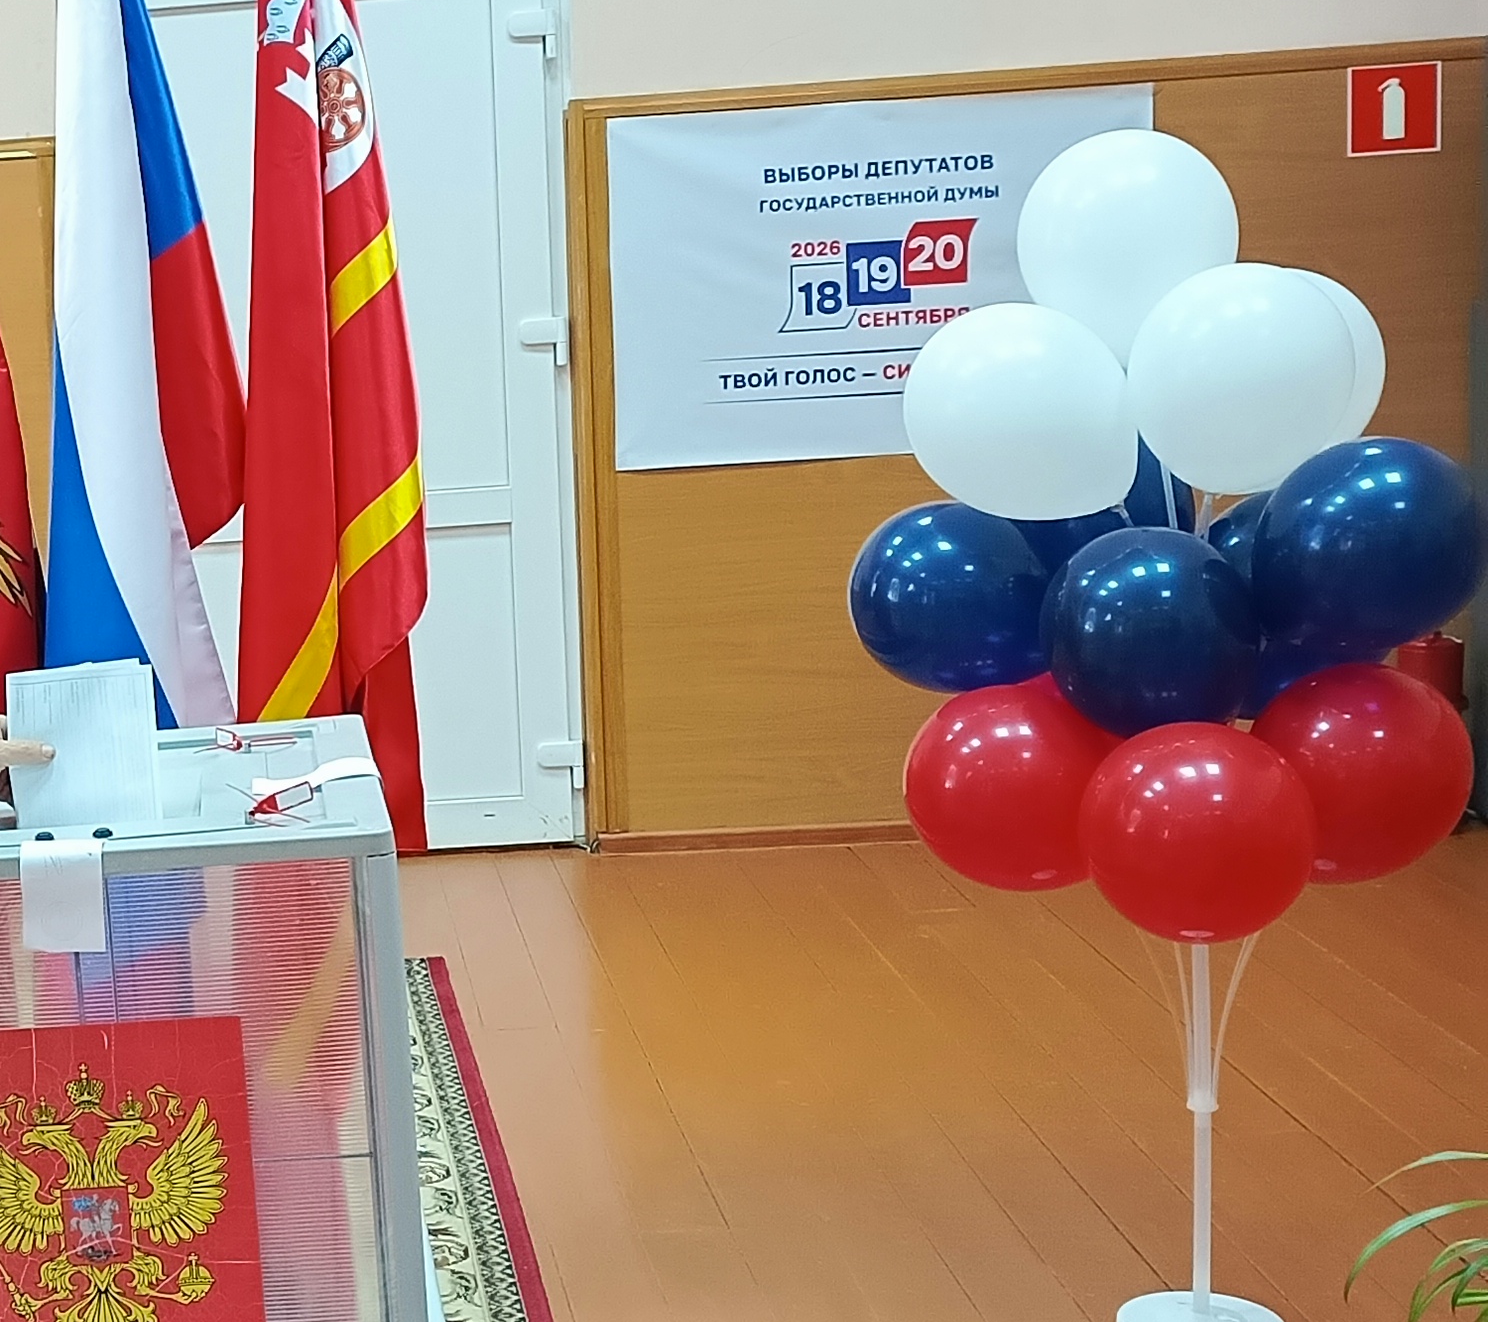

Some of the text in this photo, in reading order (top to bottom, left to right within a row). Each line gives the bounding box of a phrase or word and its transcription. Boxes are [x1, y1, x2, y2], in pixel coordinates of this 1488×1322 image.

[763, 154, 994, 184] ВЫБОРЫ ДЕПУТАТОВ
[759, 184, 1000, 213] ГОСУДАРСТВЕННОЙ ДУМЫ
[790, 240, 841, 258] 2026
[797, 233, 964, 317] 18 19 20
[718, 367, 778, 390] ТВОЙ
[784, 366, 857, 386] ГОЛОС
[882, 363, 912, 381] СИ
